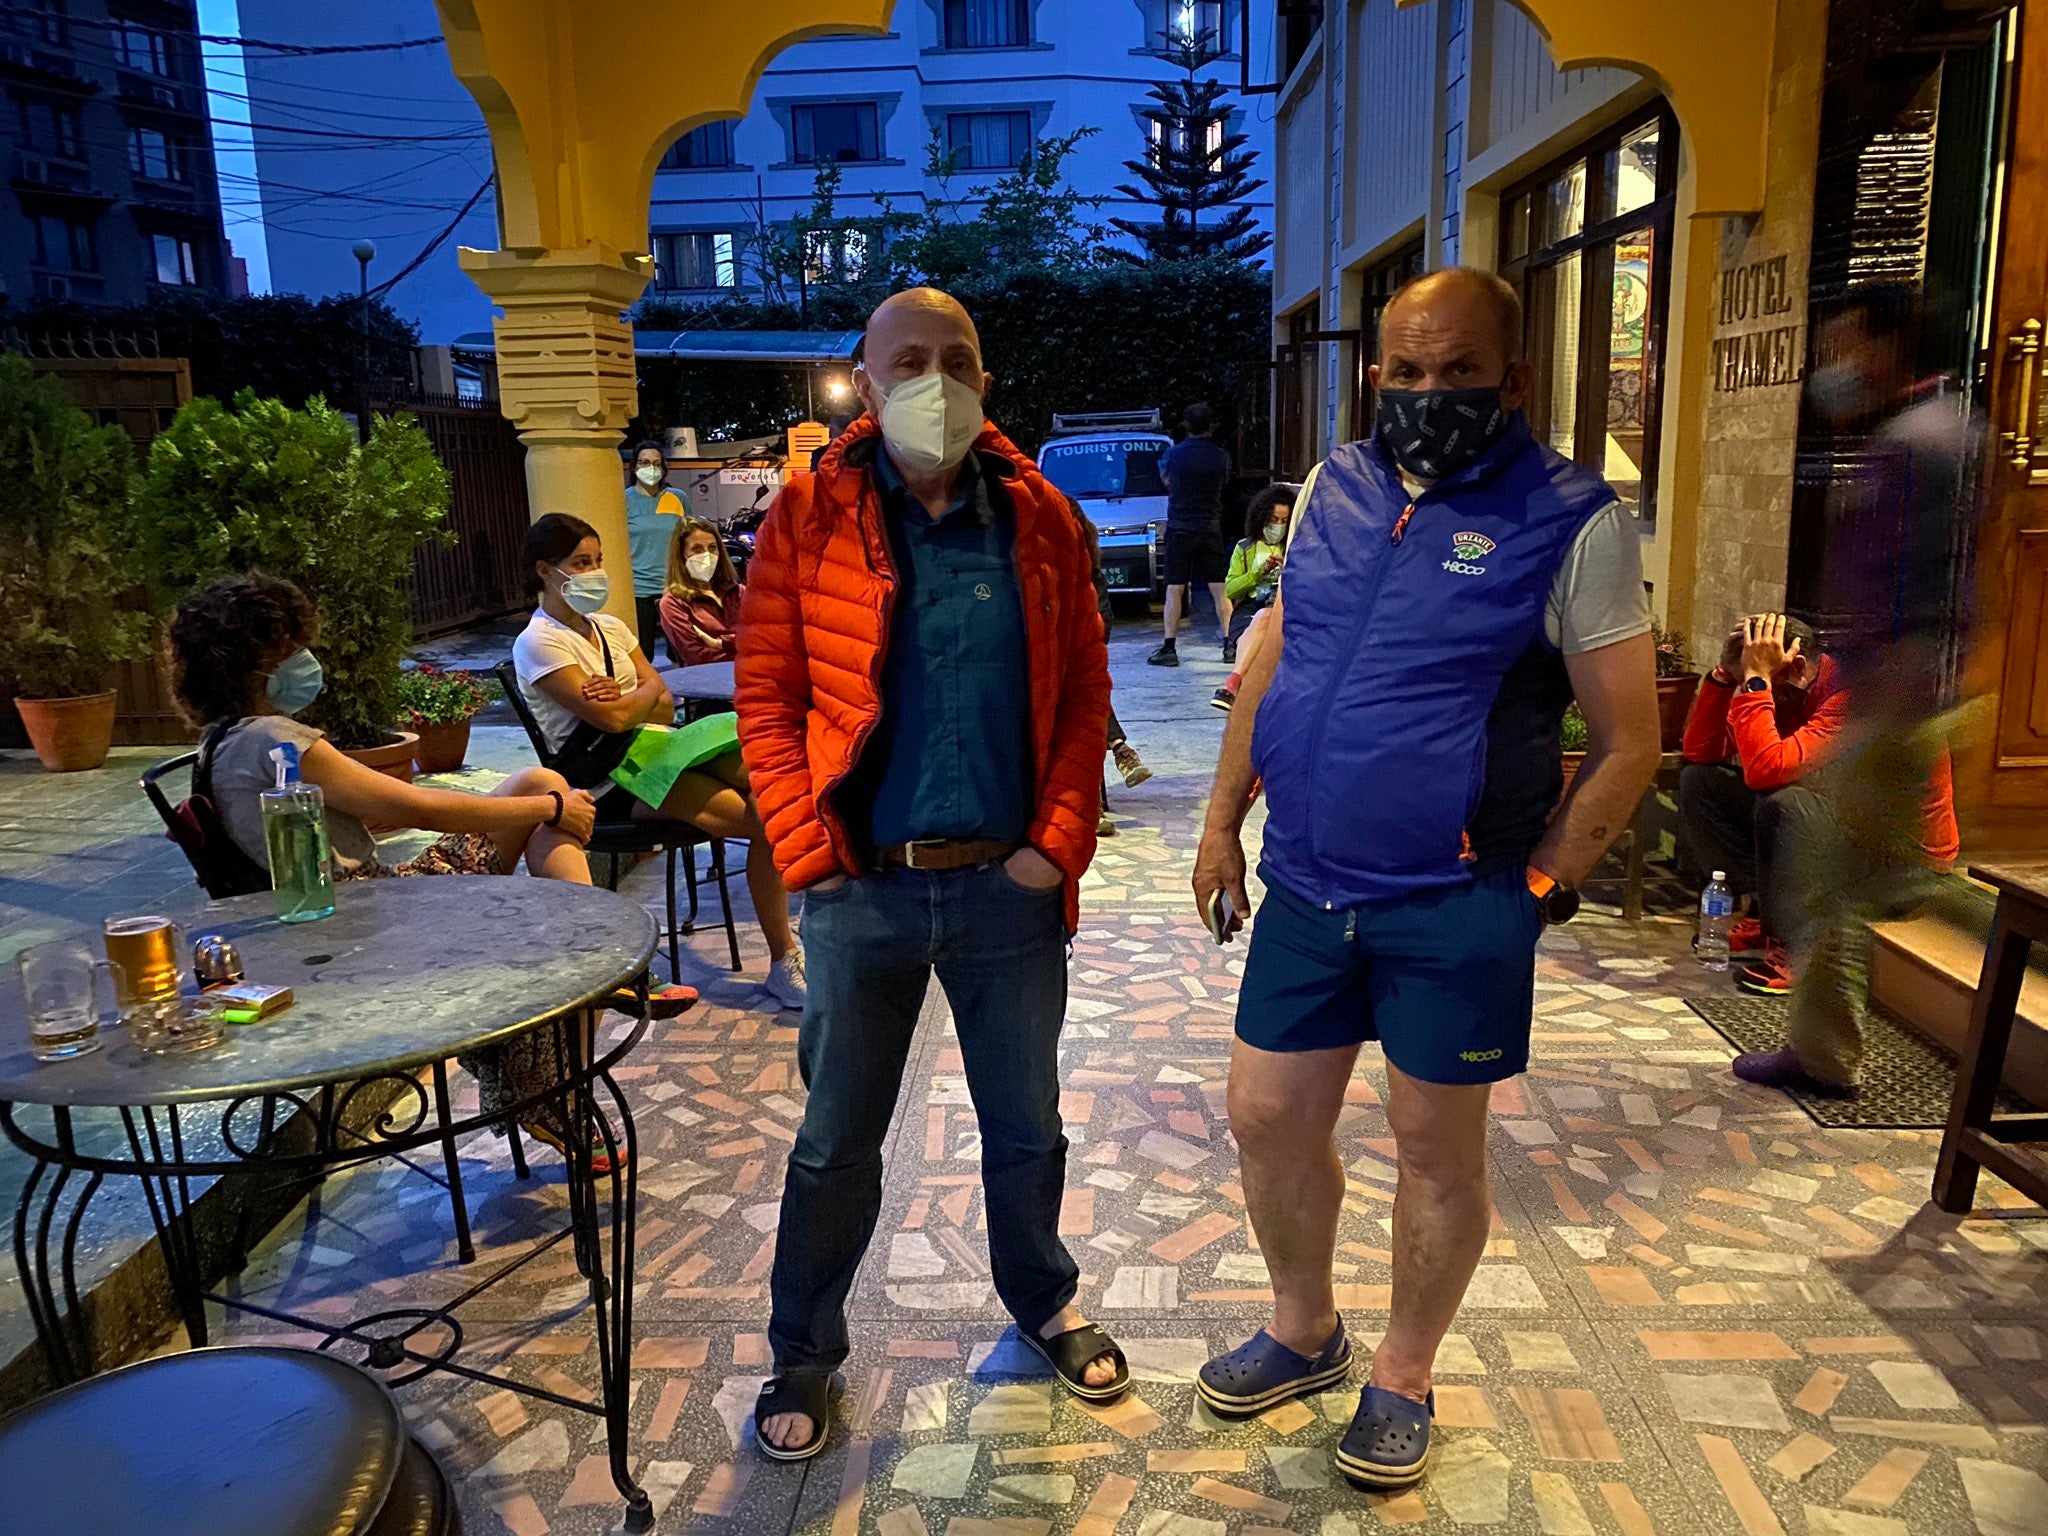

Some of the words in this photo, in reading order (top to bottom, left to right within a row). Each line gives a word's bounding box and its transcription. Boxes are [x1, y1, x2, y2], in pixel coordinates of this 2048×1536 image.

[1719, 255, 1792, 325] HOTEL
[1712, 326, 1804, 392] THAMEL
[1054, 442, 1118, 457] TOURIST
[1122, 441, 1162, 452] ONLY
[1457, 534, 1491, 549] URZANTE
[1441, 560, 1486, 575] +8000
[1459, 1048, 1503, 1062] +8000
